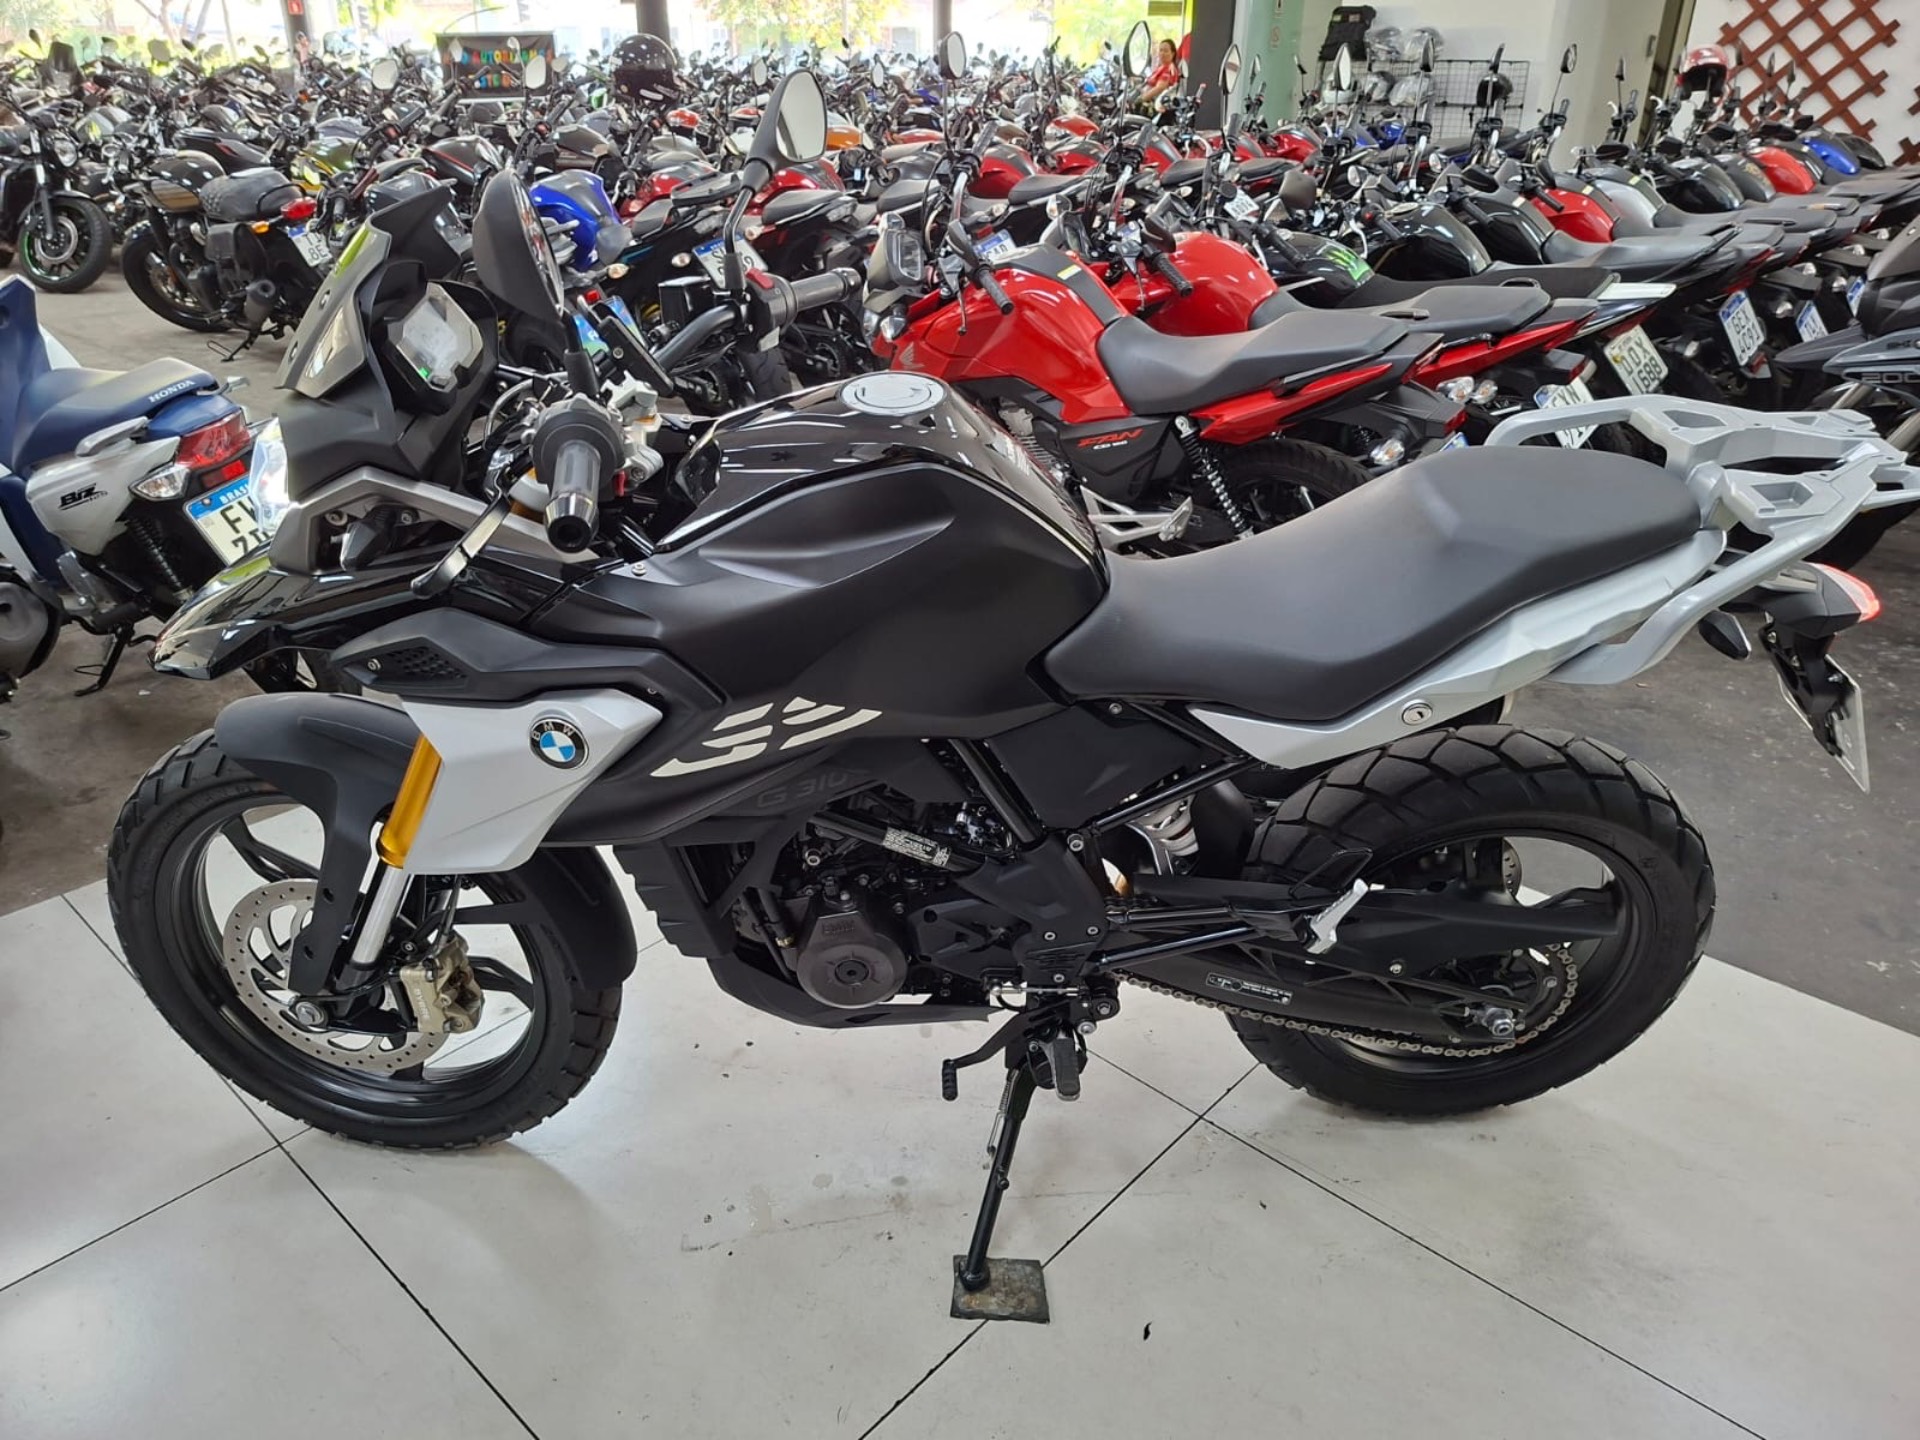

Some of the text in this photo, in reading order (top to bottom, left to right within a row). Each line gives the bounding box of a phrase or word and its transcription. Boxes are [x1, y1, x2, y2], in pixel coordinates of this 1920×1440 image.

[1631, 355, 1663, 395] 1688
[149, 379, 195, 402] HONDA
[219, 483, 251, 505] BRAS
[757, 771, 848, 809] G 310
